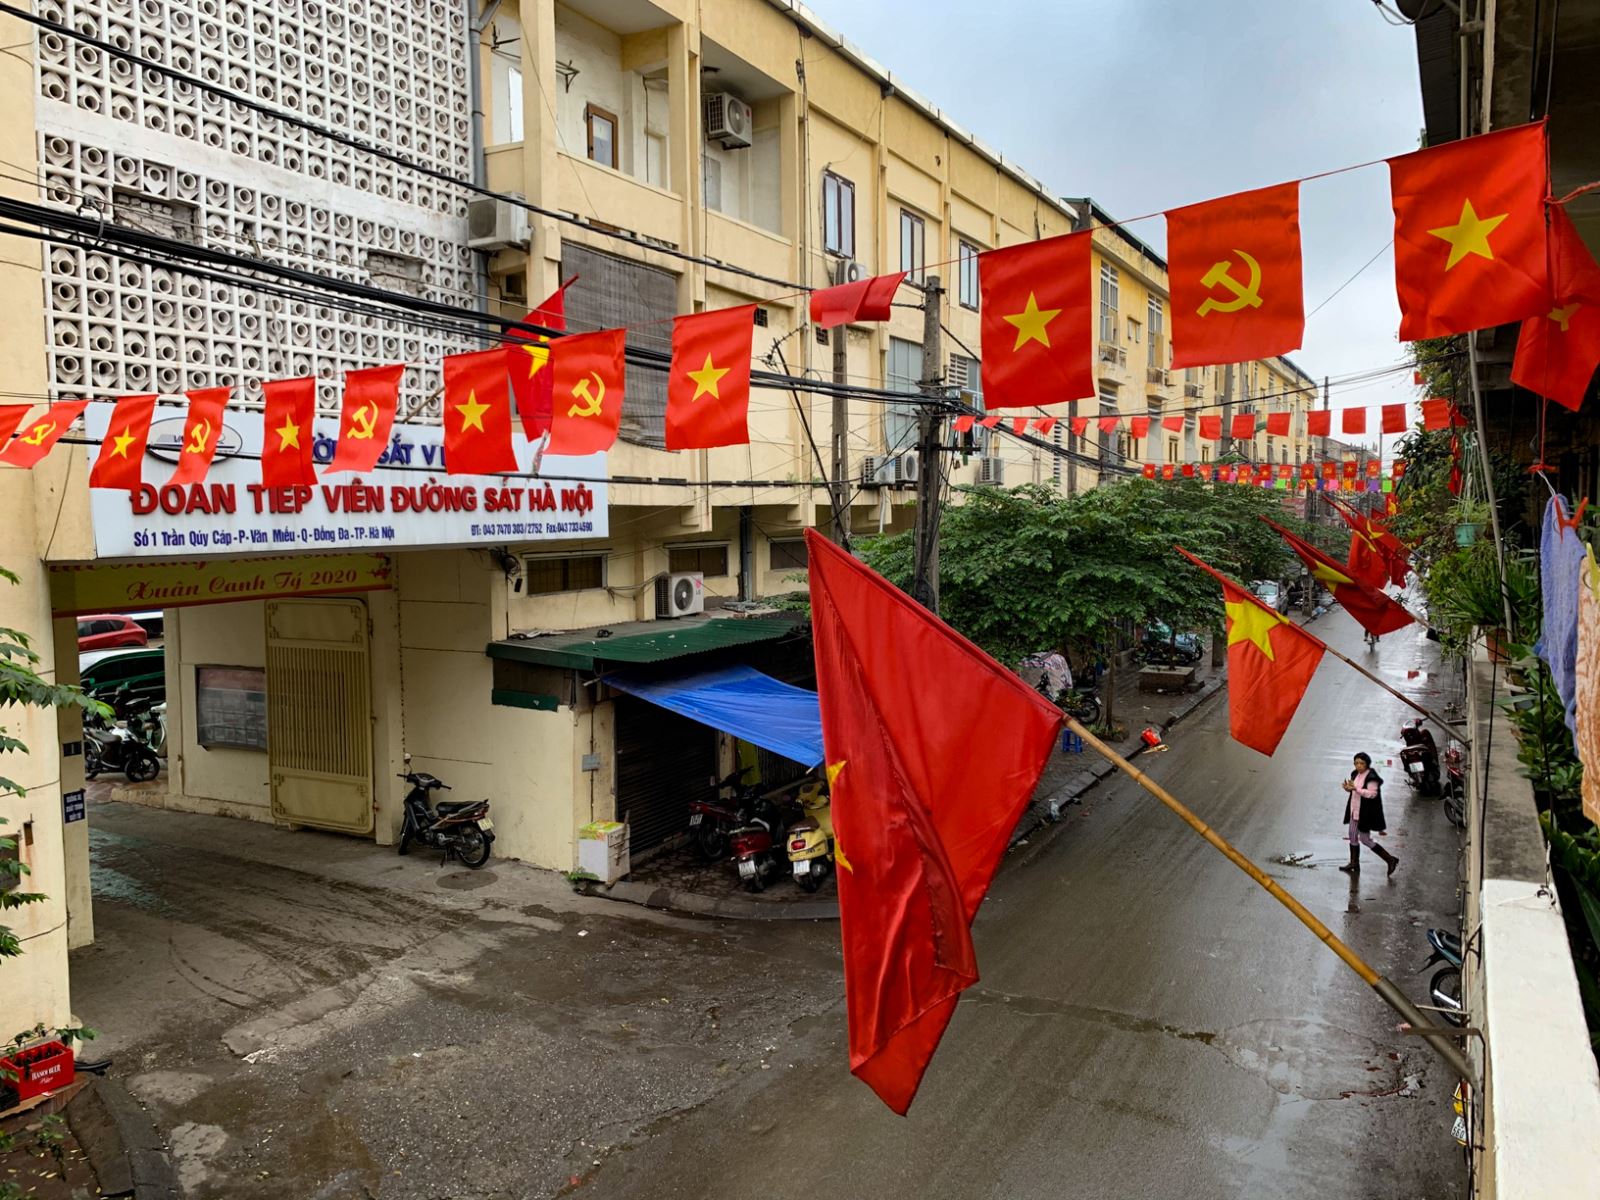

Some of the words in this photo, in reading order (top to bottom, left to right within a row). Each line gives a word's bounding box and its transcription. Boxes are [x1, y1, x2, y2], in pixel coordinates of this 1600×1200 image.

[321, 477, 385, 513] VIÊN
[390, 477, 478, 513] ĐƯỜNG
[529, 482, 557, 512] HÀ
[561, 483, 593, 516] NỘI
[134, 528, 149, 547] Số
[151, 532, 157, 547] 1
[161, 528, 185, 546] Trần
[126, 580, 200, 600] Xuân
[208, 575, 265, 594] Canh
[310, 569, 357, 586] 2020
